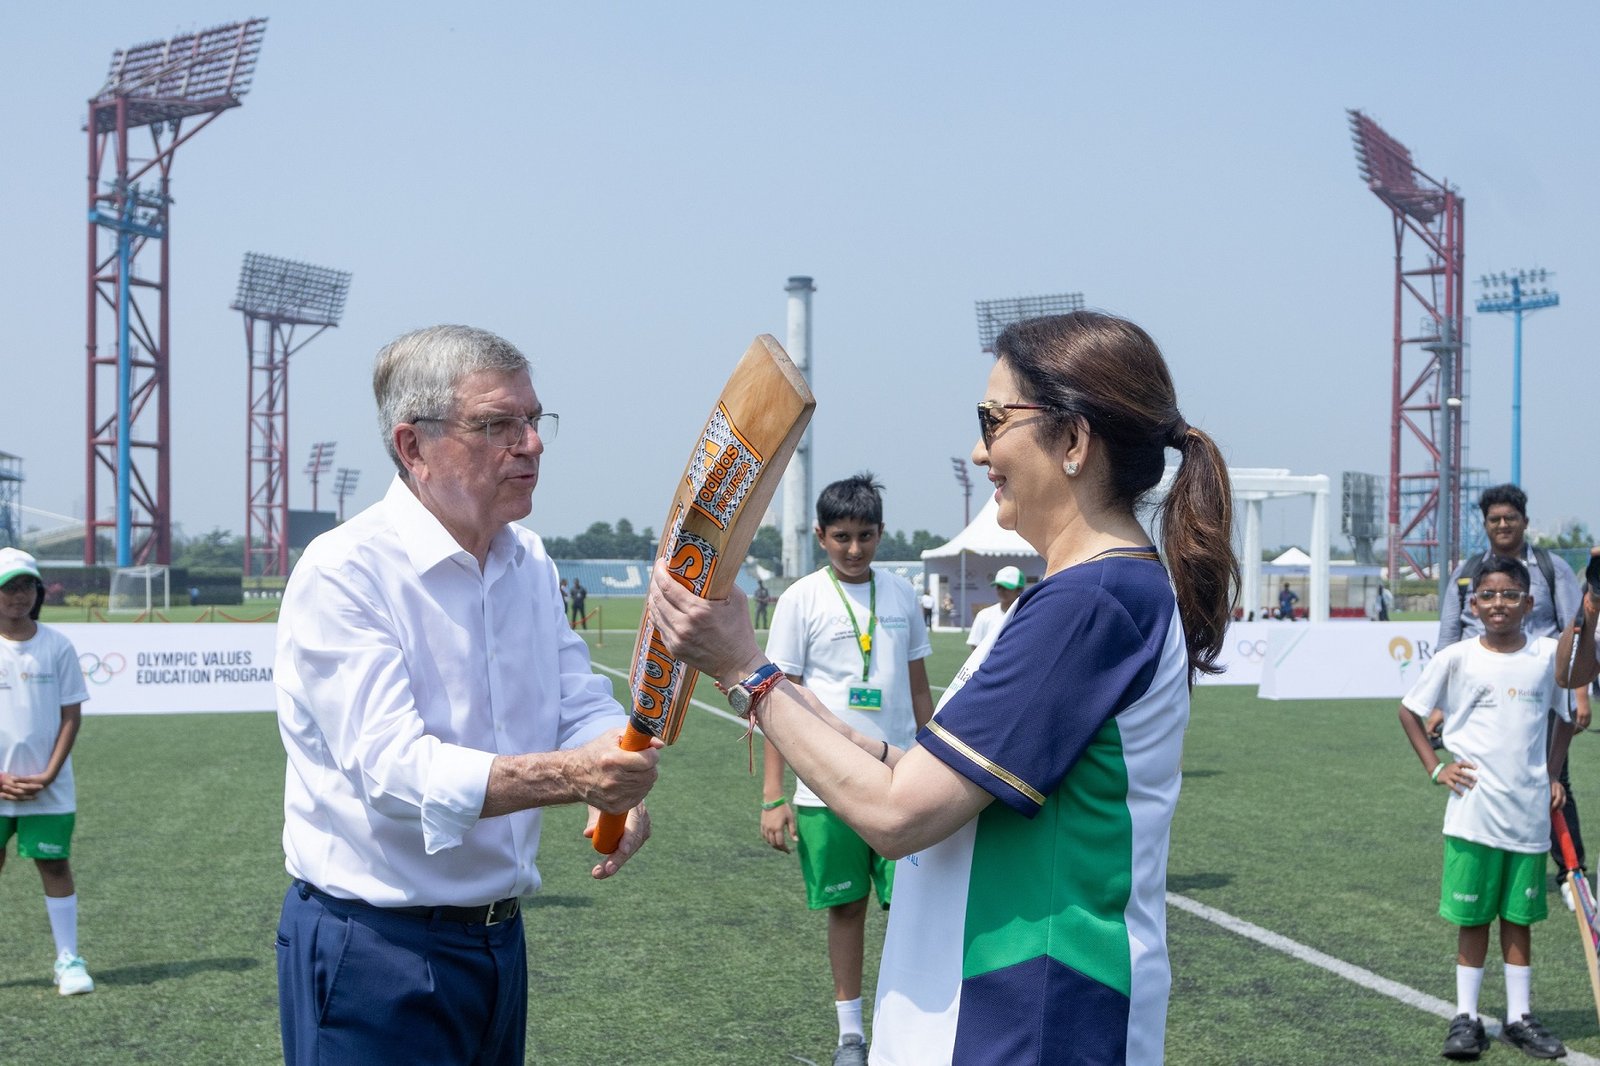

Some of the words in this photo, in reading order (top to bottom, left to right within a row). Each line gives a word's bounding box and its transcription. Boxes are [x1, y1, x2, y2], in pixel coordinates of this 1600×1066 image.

[698, 443, 740, 503] adidas
[715, 461, 752, 514] INCURZA
[136, 668, 211, 684] EDUCATION
[137, 651, 198, 667] OLYMPIC
[202, 650, 252, 666] VALUES
